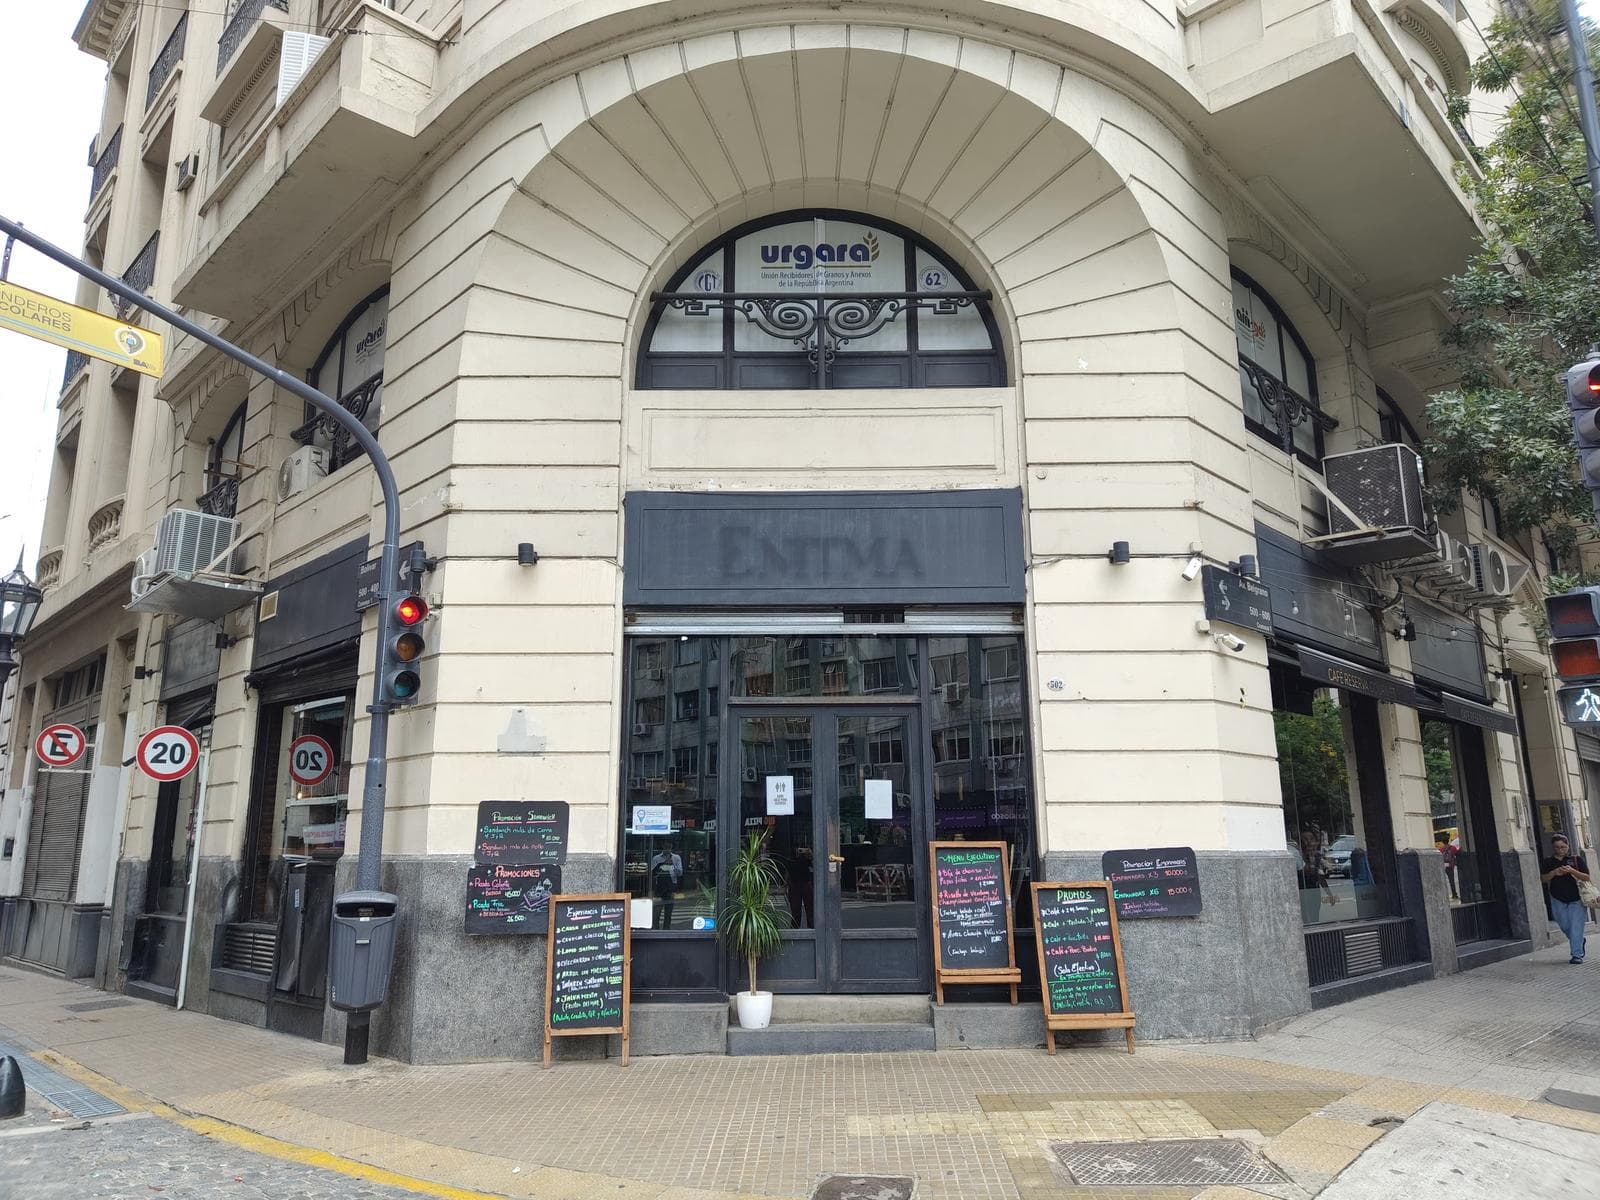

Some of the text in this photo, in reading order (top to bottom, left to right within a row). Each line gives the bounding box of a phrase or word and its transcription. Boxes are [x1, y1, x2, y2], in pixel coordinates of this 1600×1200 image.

[761, 244, 870, 269] urgara
[761, 271, 779, 279] Unión
[780, 271, 814, 279] Recibidores
[824, 271, 844, 279] Granos
[850, 271, 871, 279] Anexos
[926, 273, 941, 286] 62
[779, 280, 786, 288] de
[824, 279, 854, 289] Argentina
[1050, 680, 1063, 689] 502
[150, 742, 186, 764] 20
[1057, 890, 1092, 902] PROMOS
